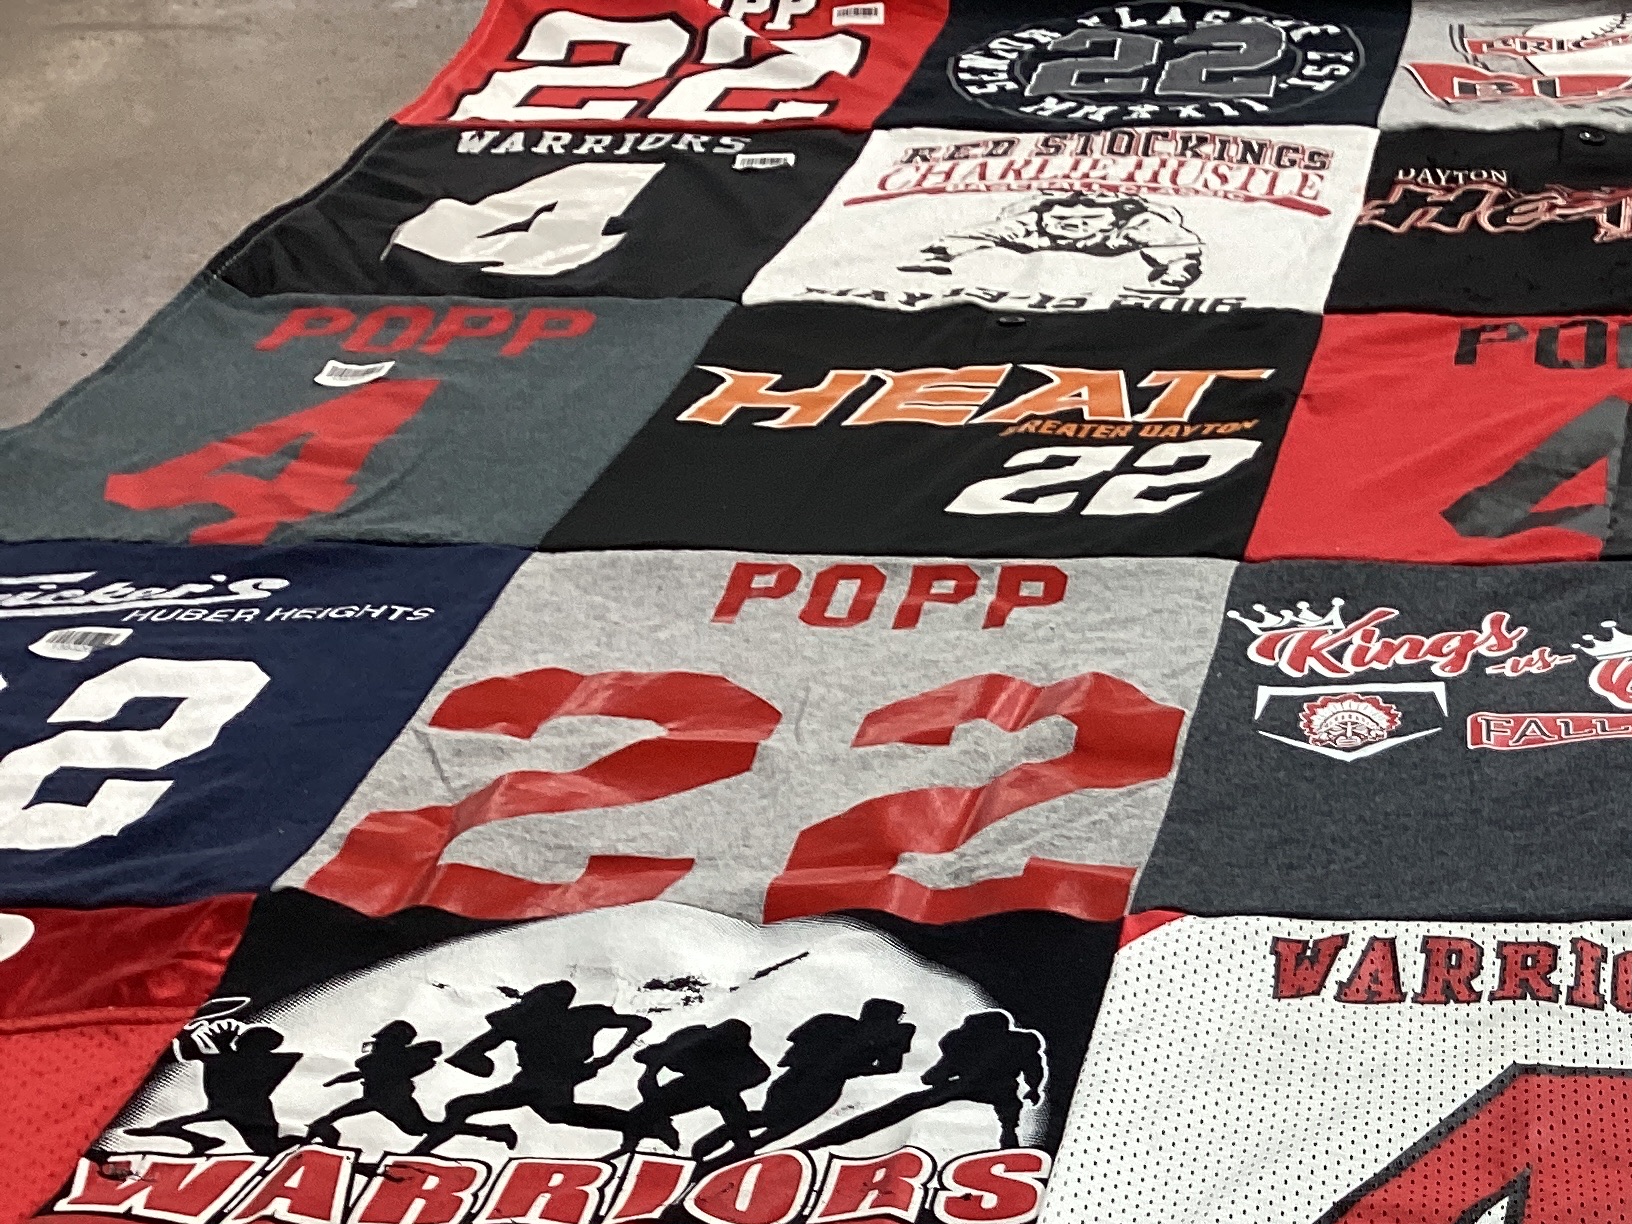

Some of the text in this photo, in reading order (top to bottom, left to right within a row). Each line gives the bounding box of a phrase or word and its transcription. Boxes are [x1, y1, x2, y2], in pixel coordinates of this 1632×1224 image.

[707, 0, 818, 31] PP
[446, 10, 872, 124] 22
[1023, 21, 1287, 98] 22
[456, 129, 752, 156] WARRIORS
[899, 127, 1336, 171] RED STOCKINGS
[876, 154, 1116, 193] CHARLIE
[1122, 155, 1327, 200] HUSTLE
[1397, 168, 1509, 186] DAYTON
[380, 161, 667, 276] 4
[254, 305, 598, 357] POPP
[675, 363, 1278, 429] HEAT
[1138, 418, 1261, 438] DAYTON
[103, 377, 443, 546] 4
[943, 439, 1263, 517] 22
[121, 603, 438, 624] HUBER HEIGHTS
[710, 560, 1069, 630] POPP
[1246, 605, 1531, 678] Kings
[303, 665, 1187, 926] 22
